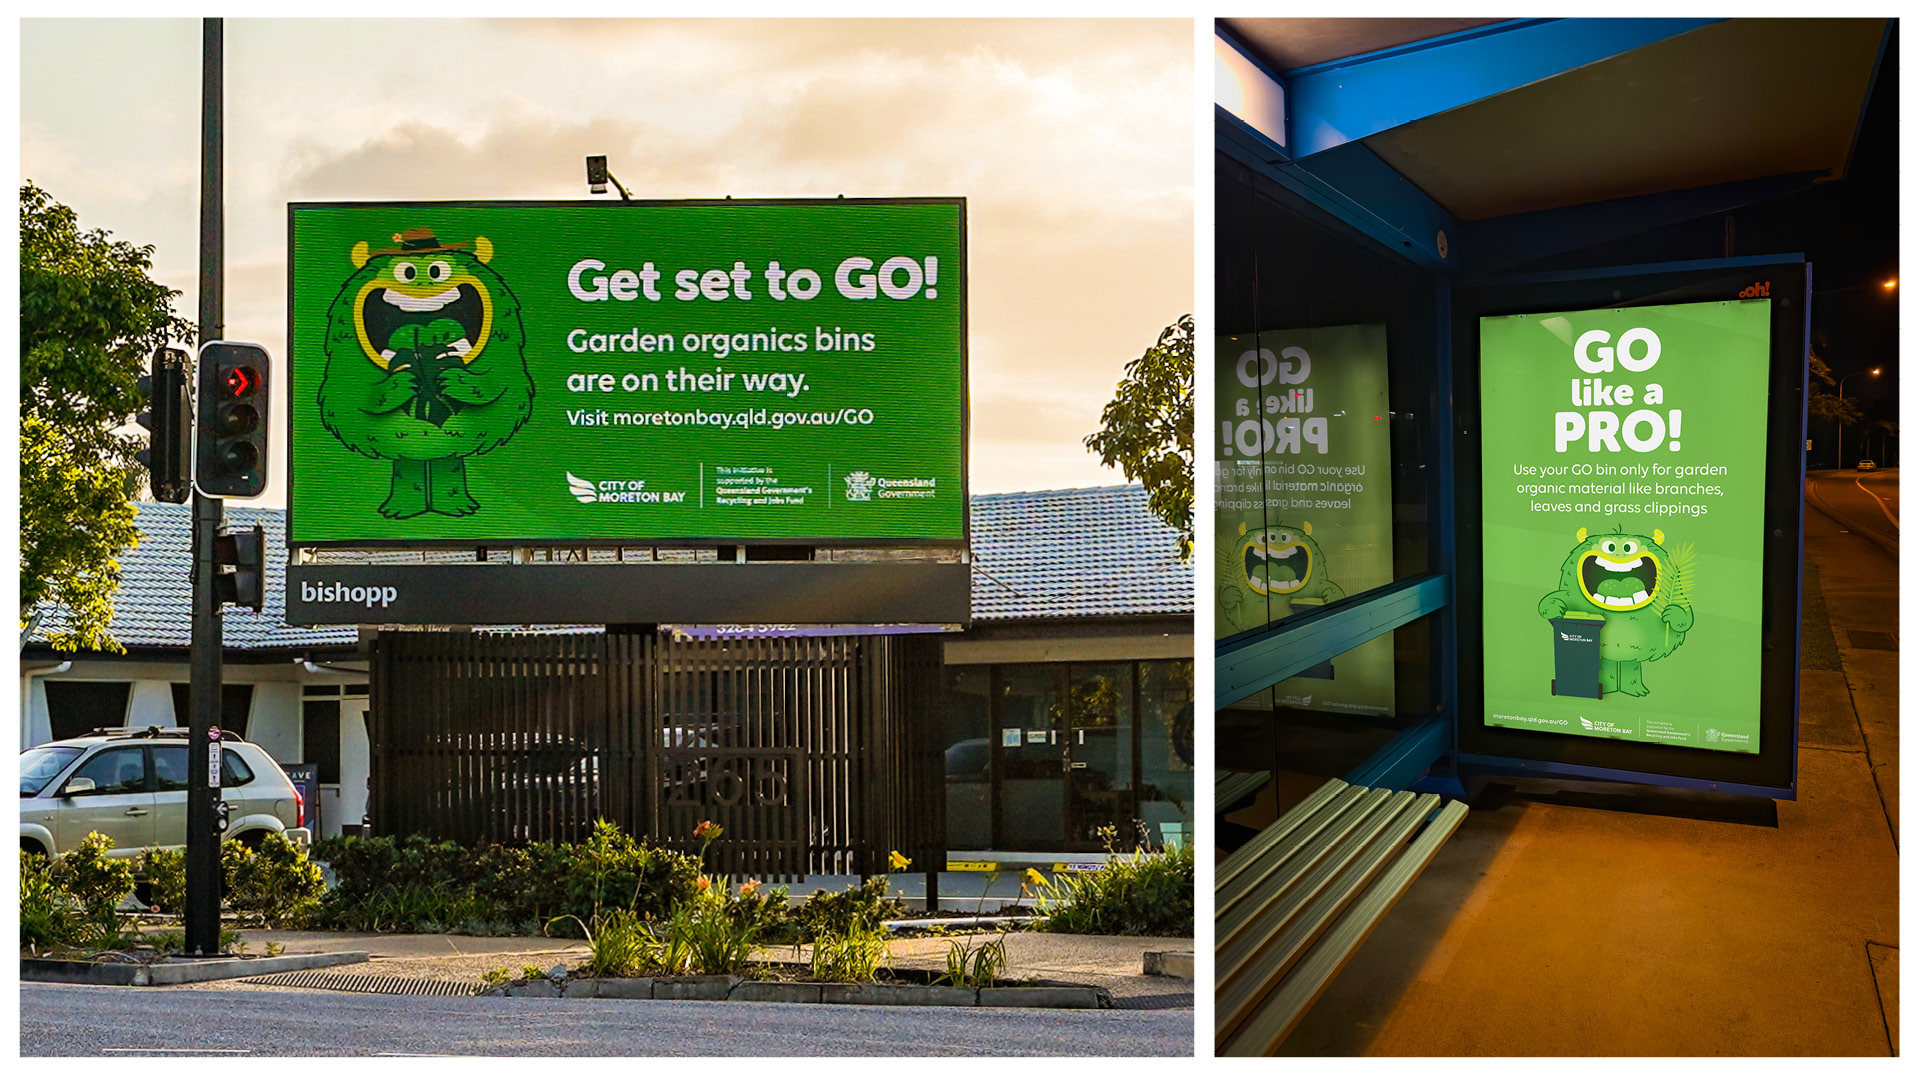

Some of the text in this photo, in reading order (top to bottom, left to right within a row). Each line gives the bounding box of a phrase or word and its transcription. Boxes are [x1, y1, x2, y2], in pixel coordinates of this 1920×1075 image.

[567, 256, 938, 301] Get set to GO!
[566, 326, 876, 358] Garden organics bins
[1574, 327, 1662, 374] GO
[566, 368, 810, 397] are on their way.
[1571, 378, 1664, 406] like a
[566, 408, 874, 430] Visit moretonbay.qld.gov.au/GO
[1554, 409, 1682, 453] PRO!
[1514, 463, 1728, 479] Use your GO bin only for garden
[599, 480, 646, 491] CITY OF
[716, 477, 754, 486] supported
[756, 477, 764, 486] by
[878, 477, 936, 488] Queensland
[1516, 482, 1724, 497] organic material like branches,
[599, 492, 686, 503] MORETON BAY
[716, 486, 812, 495] Queensland Government's
[878, 488, 936, 499] Government
[716, 496, 804, 506] Recycling and Jobs Fund
[1531, 500, 1708, 517] leaves and grass clippings
[301, 582, 398, 608] bishopp
[1492, 714, 1568, 726] moretonbay.qld.gov.au/GO
